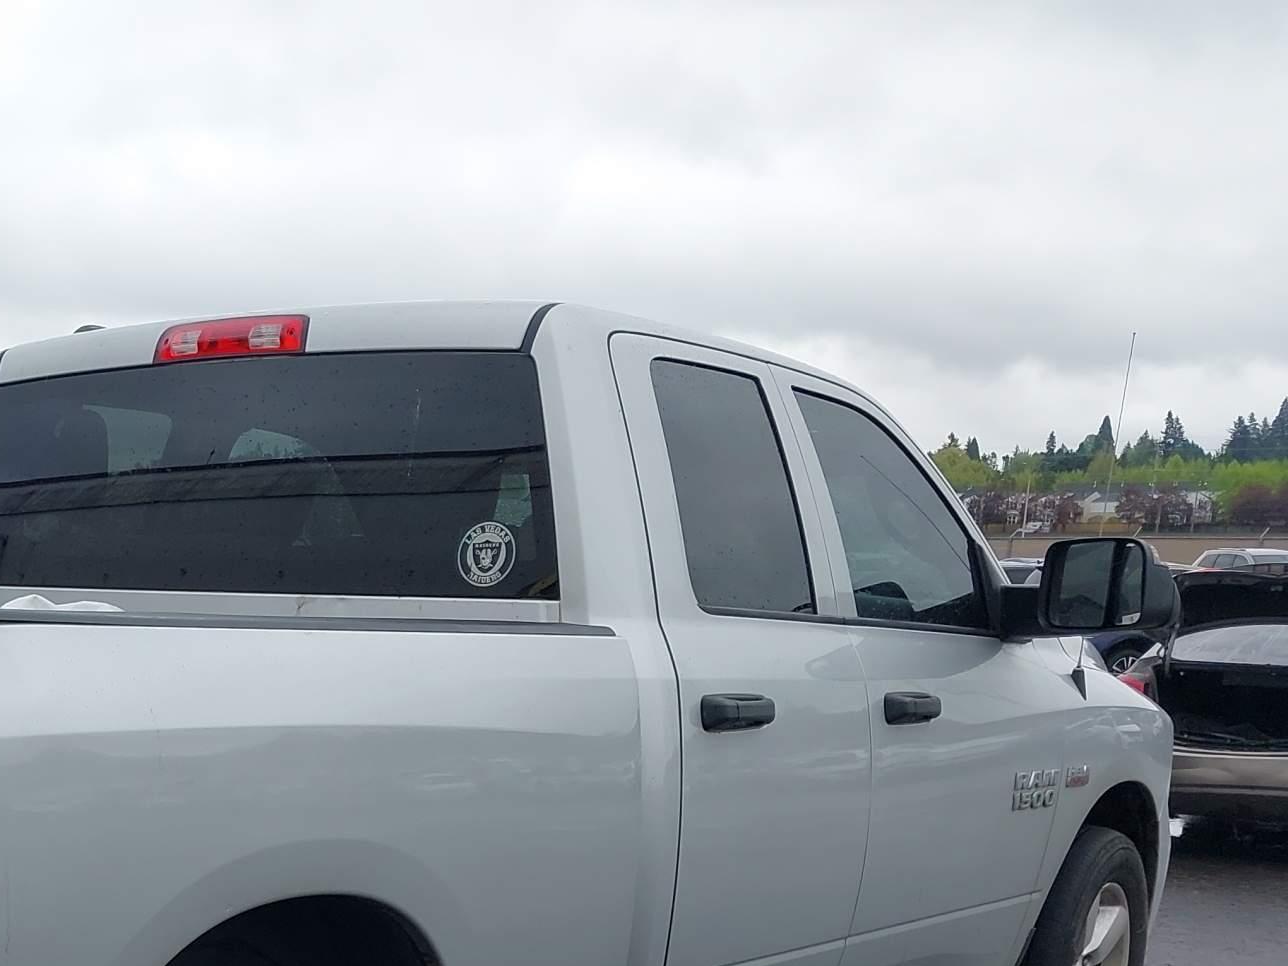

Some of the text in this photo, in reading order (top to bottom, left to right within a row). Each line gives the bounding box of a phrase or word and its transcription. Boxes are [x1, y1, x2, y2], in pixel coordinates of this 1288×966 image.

[465, 525, 511, 545] LAS VEGAS
[1014, 769, 1060, 791] RAM
[1012, 789, 1056, 811] 1500
